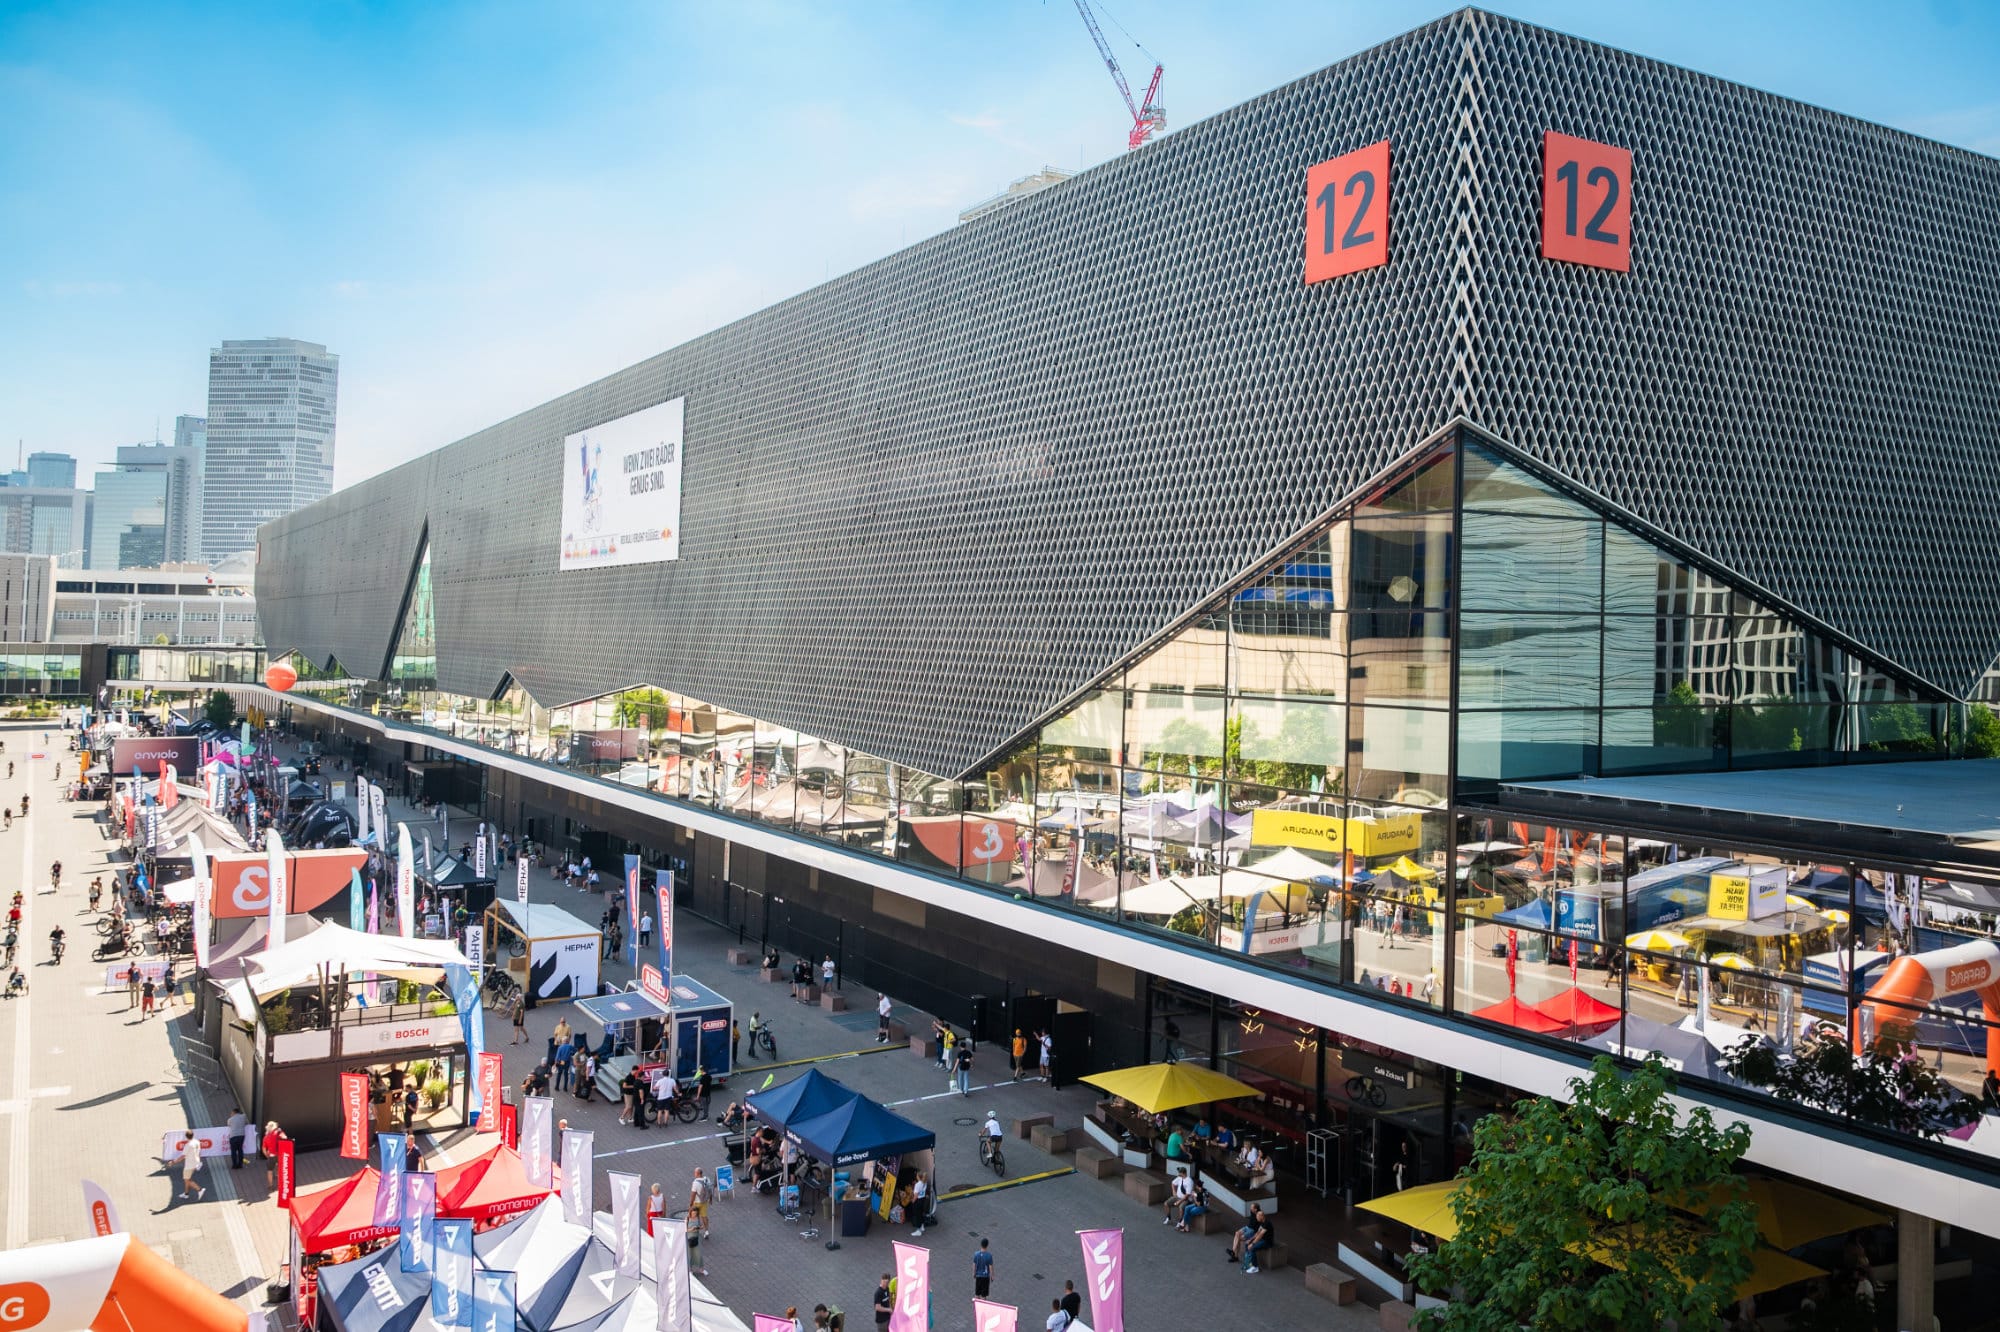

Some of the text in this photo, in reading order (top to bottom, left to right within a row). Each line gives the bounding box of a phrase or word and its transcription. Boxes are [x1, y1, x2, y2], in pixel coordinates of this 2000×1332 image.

[1315, 170, 1375, 255] 12
[1556, 160, 1619, 245] 12
[623, 440, 675, 474] WENN ZWEI RÄDER
[629, 473, 649, 496] GENUG
[134, 749, 179, 760] enviolo
[520, 866, 528, 899] HEPHA
[565, 943, 593, 951] HEPHA
[395, 1028, 430, 1039] BOSCH
[837, 1154, 852, 1164] Selle
[488, 1197, 543, 1214] momentum
[362, 1262, 405, 1312] GIANT
